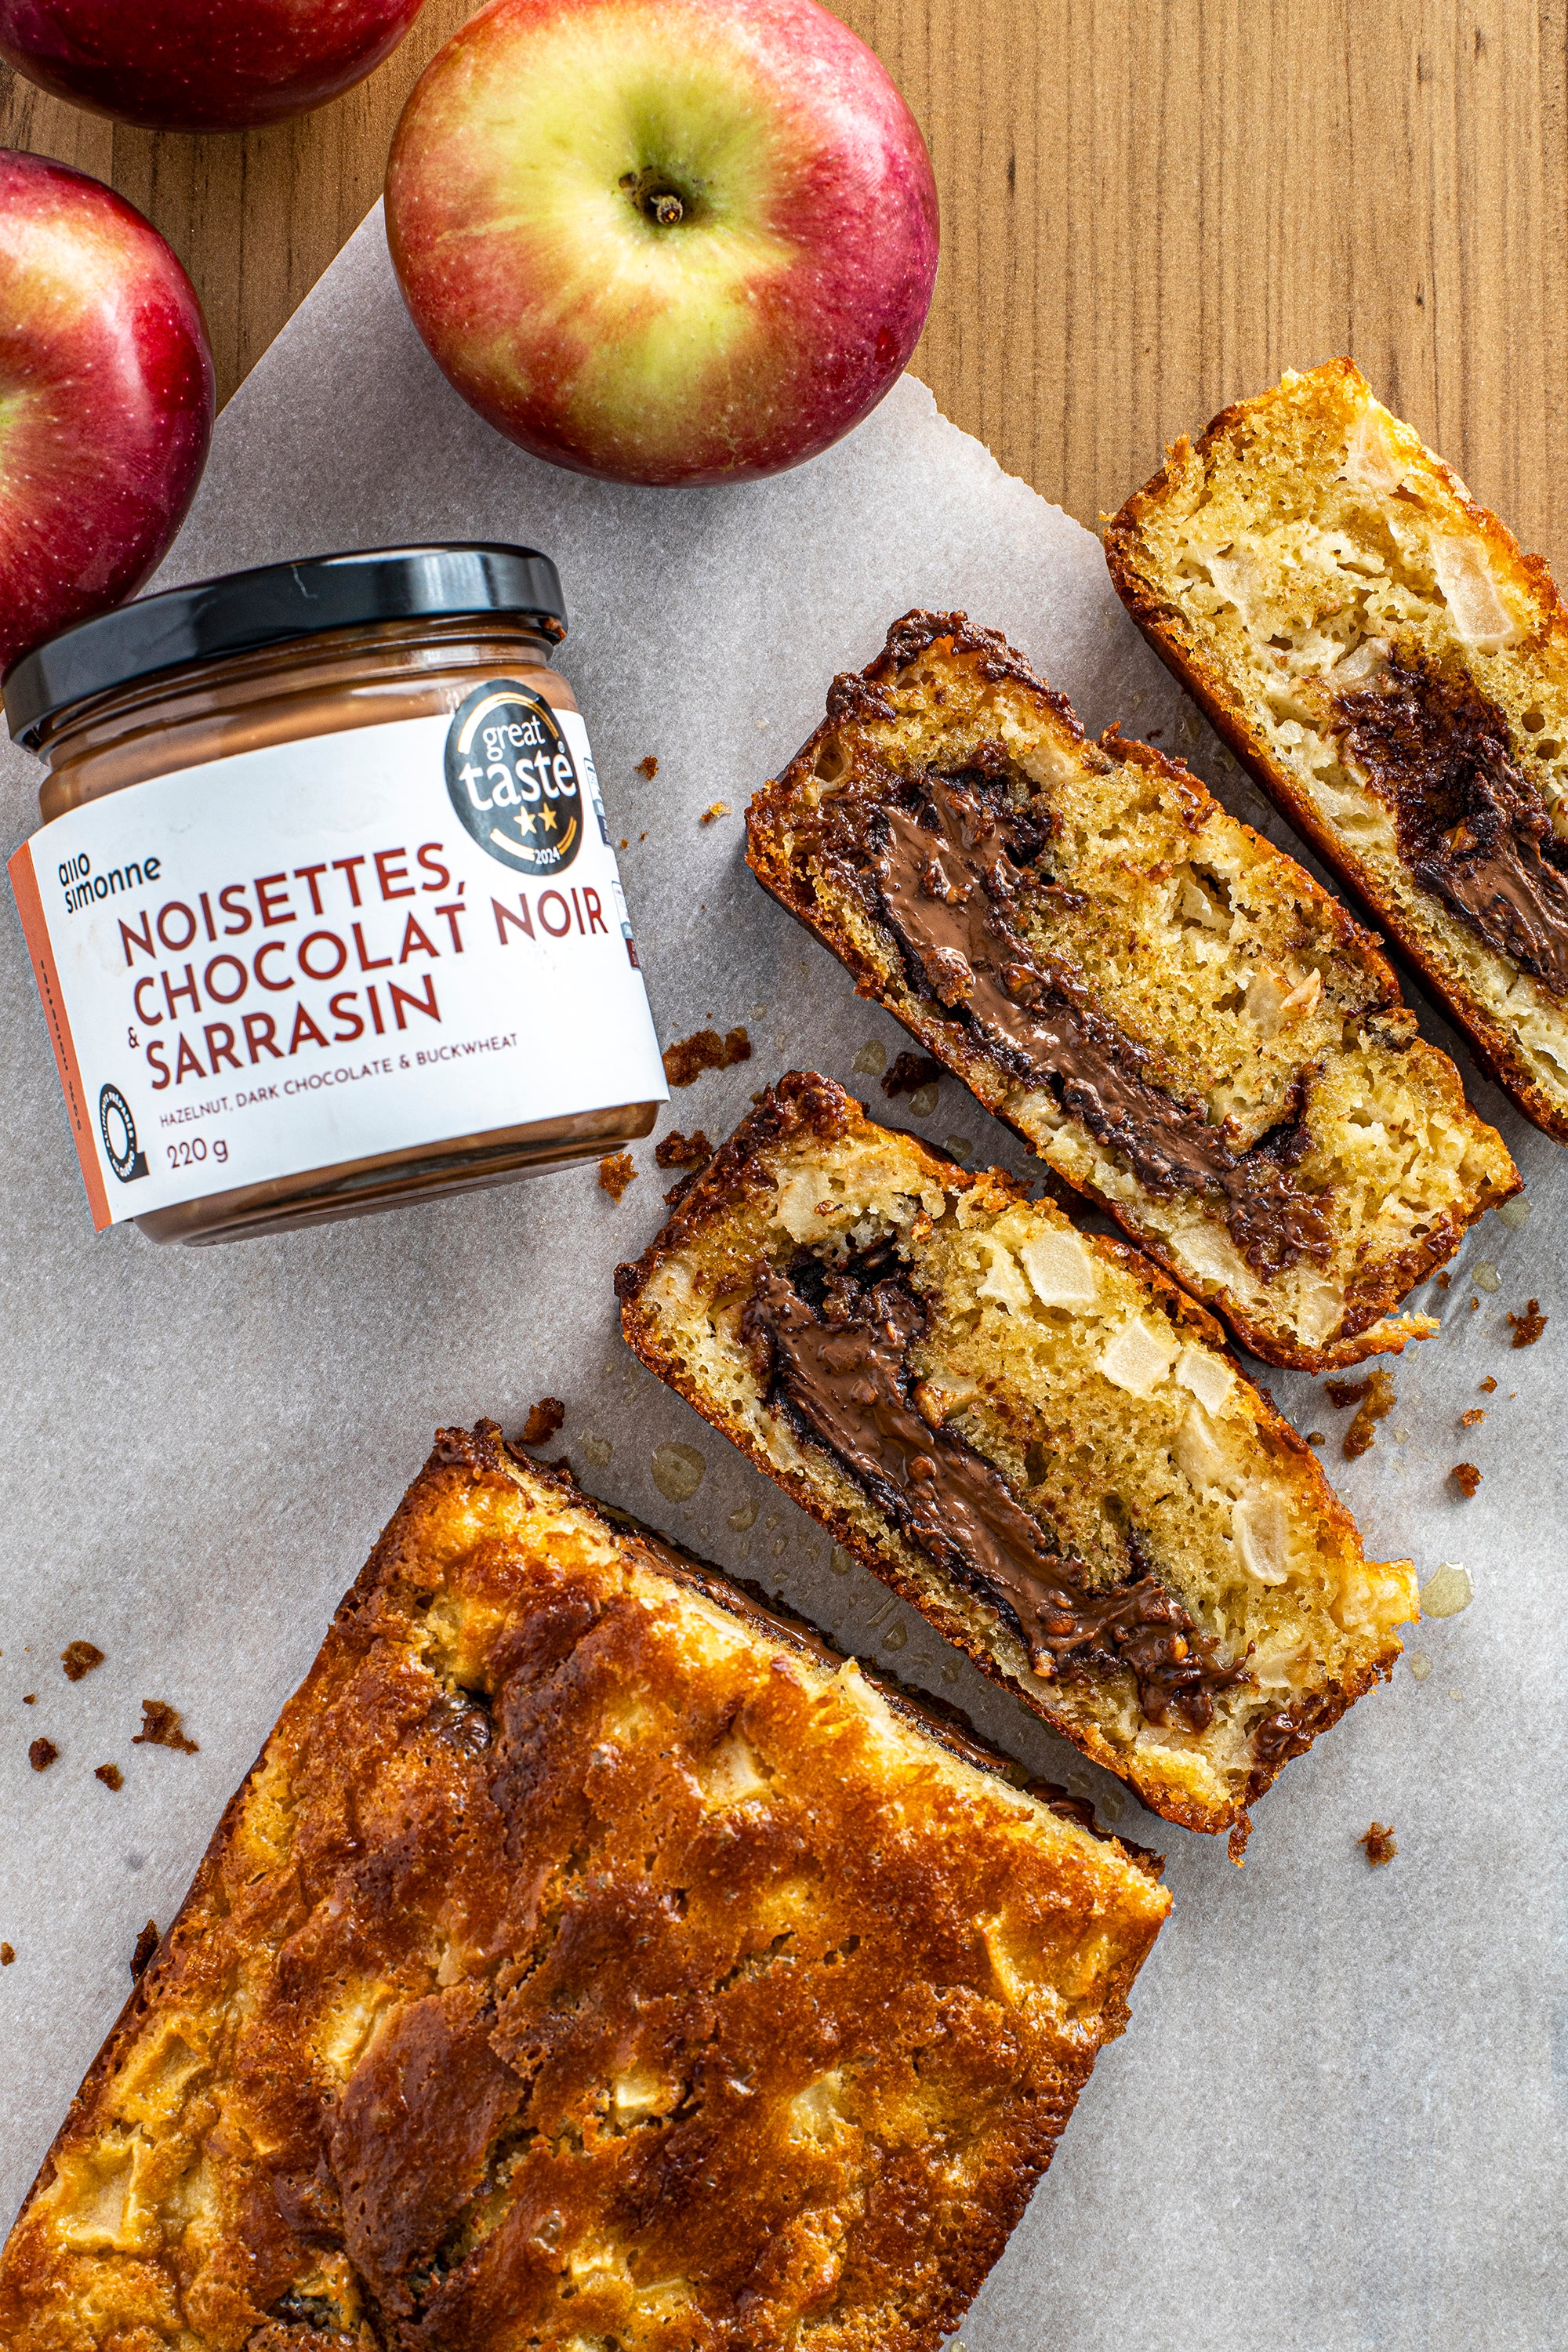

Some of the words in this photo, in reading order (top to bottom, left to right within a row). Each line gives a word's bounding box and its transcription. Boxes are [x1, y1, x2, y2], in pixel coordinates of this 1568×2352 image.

[482, 715, 546, 761] great
[459, 750, 577, 811] taste
[59, 853, 90, 887] allo
[534, 846, 561, 865] 2024
[65, 857, 161, 914] simonne
[118, 843, 465, 967] NOISETTES,
[134, 902, 466, 1025] CHOCOLAT
[491, 887, 608, 946] NOIR
[128, 1026, 140, 1048] &
[146, 974, 441, 1090] SARRASIN
[159, 1097, 234, 1127] HAZELNUT,
[236, 1084, 280, 1108] DARK
[284, 1058, 392, 1094] CHOCOLATE
[399, 1054, 410, 1069] &
[416, 1033, 517, 1065] BUCKWHEAT
[167, 1138, 207, 1168] 220
[212, 1140, 229, 1163] g
